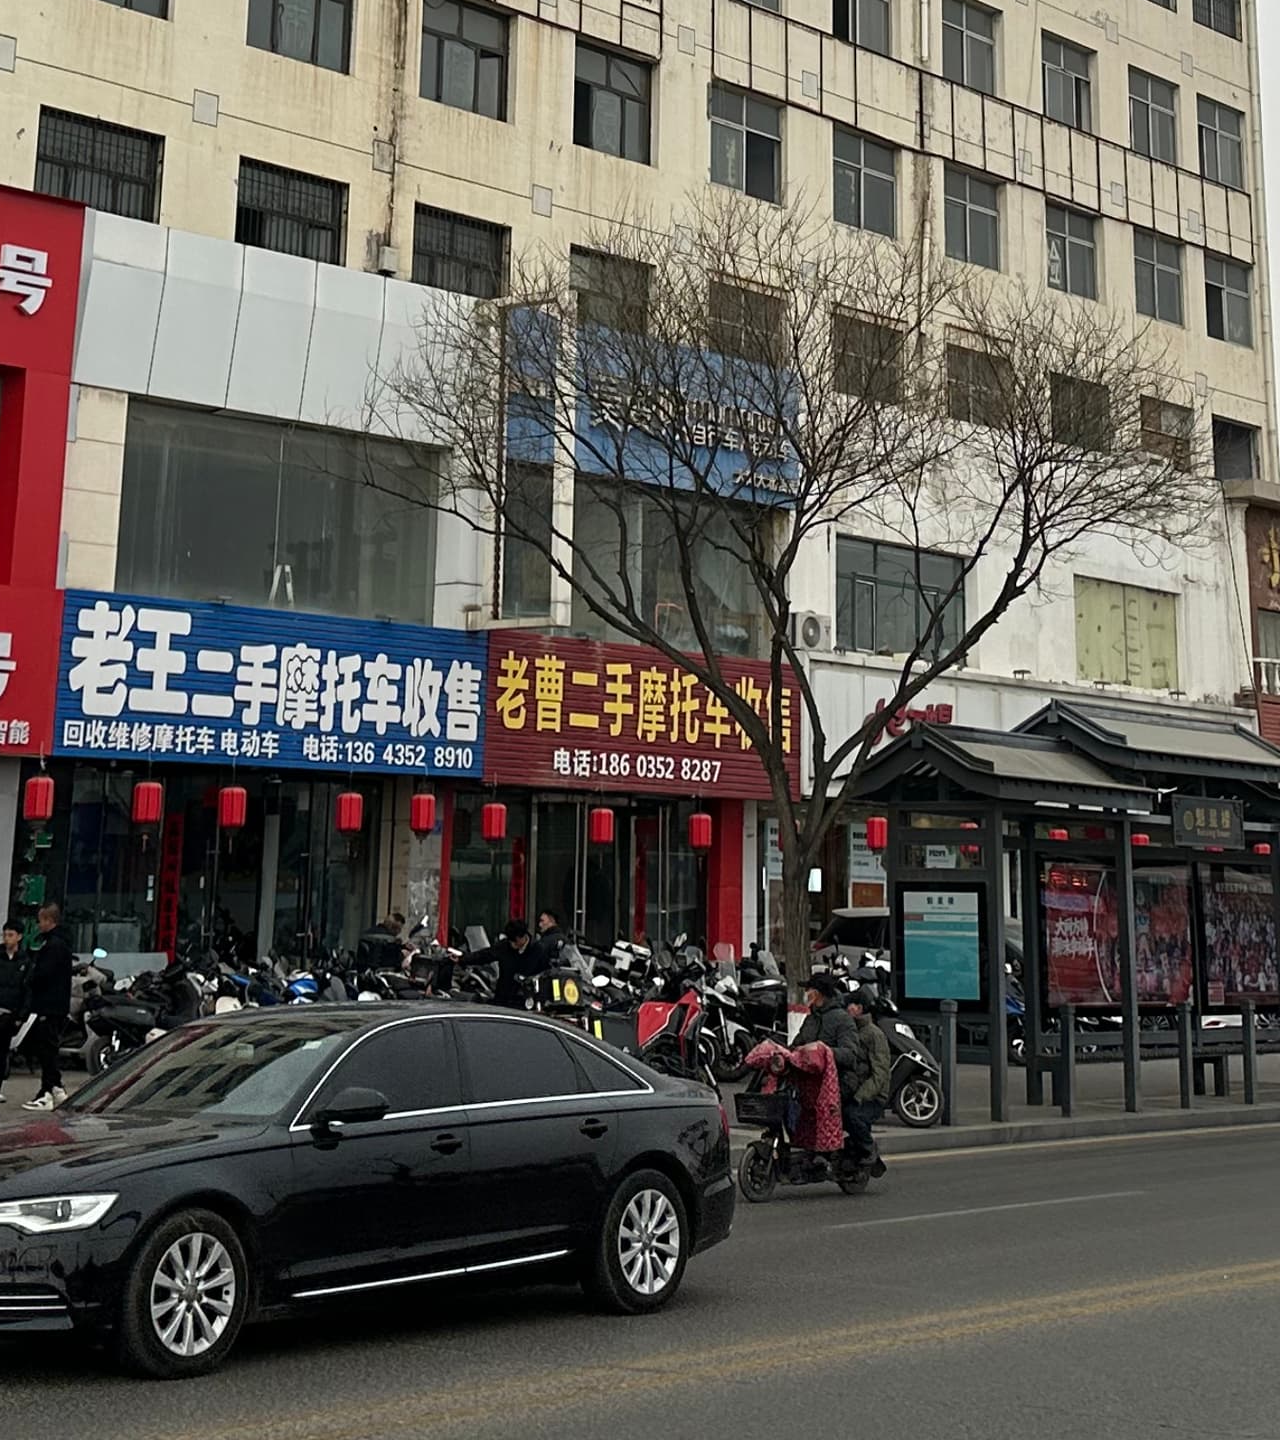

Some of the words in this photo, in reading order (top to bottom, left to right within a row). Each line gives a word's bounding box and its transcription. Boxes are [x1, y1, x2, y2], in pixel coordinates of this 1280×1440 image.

[68, 598, 485, 743] 老王二手摩托车收售
[62, 720, 216, 755] 回收维修摩托车
[220, 726, 280, 759] 电动车
[383, 741, 426, 768] 4352
[434, 746, 473, 770] 8910
[636, 752, 675, 780] 0352
[680, 758, 722, 783] 8287
